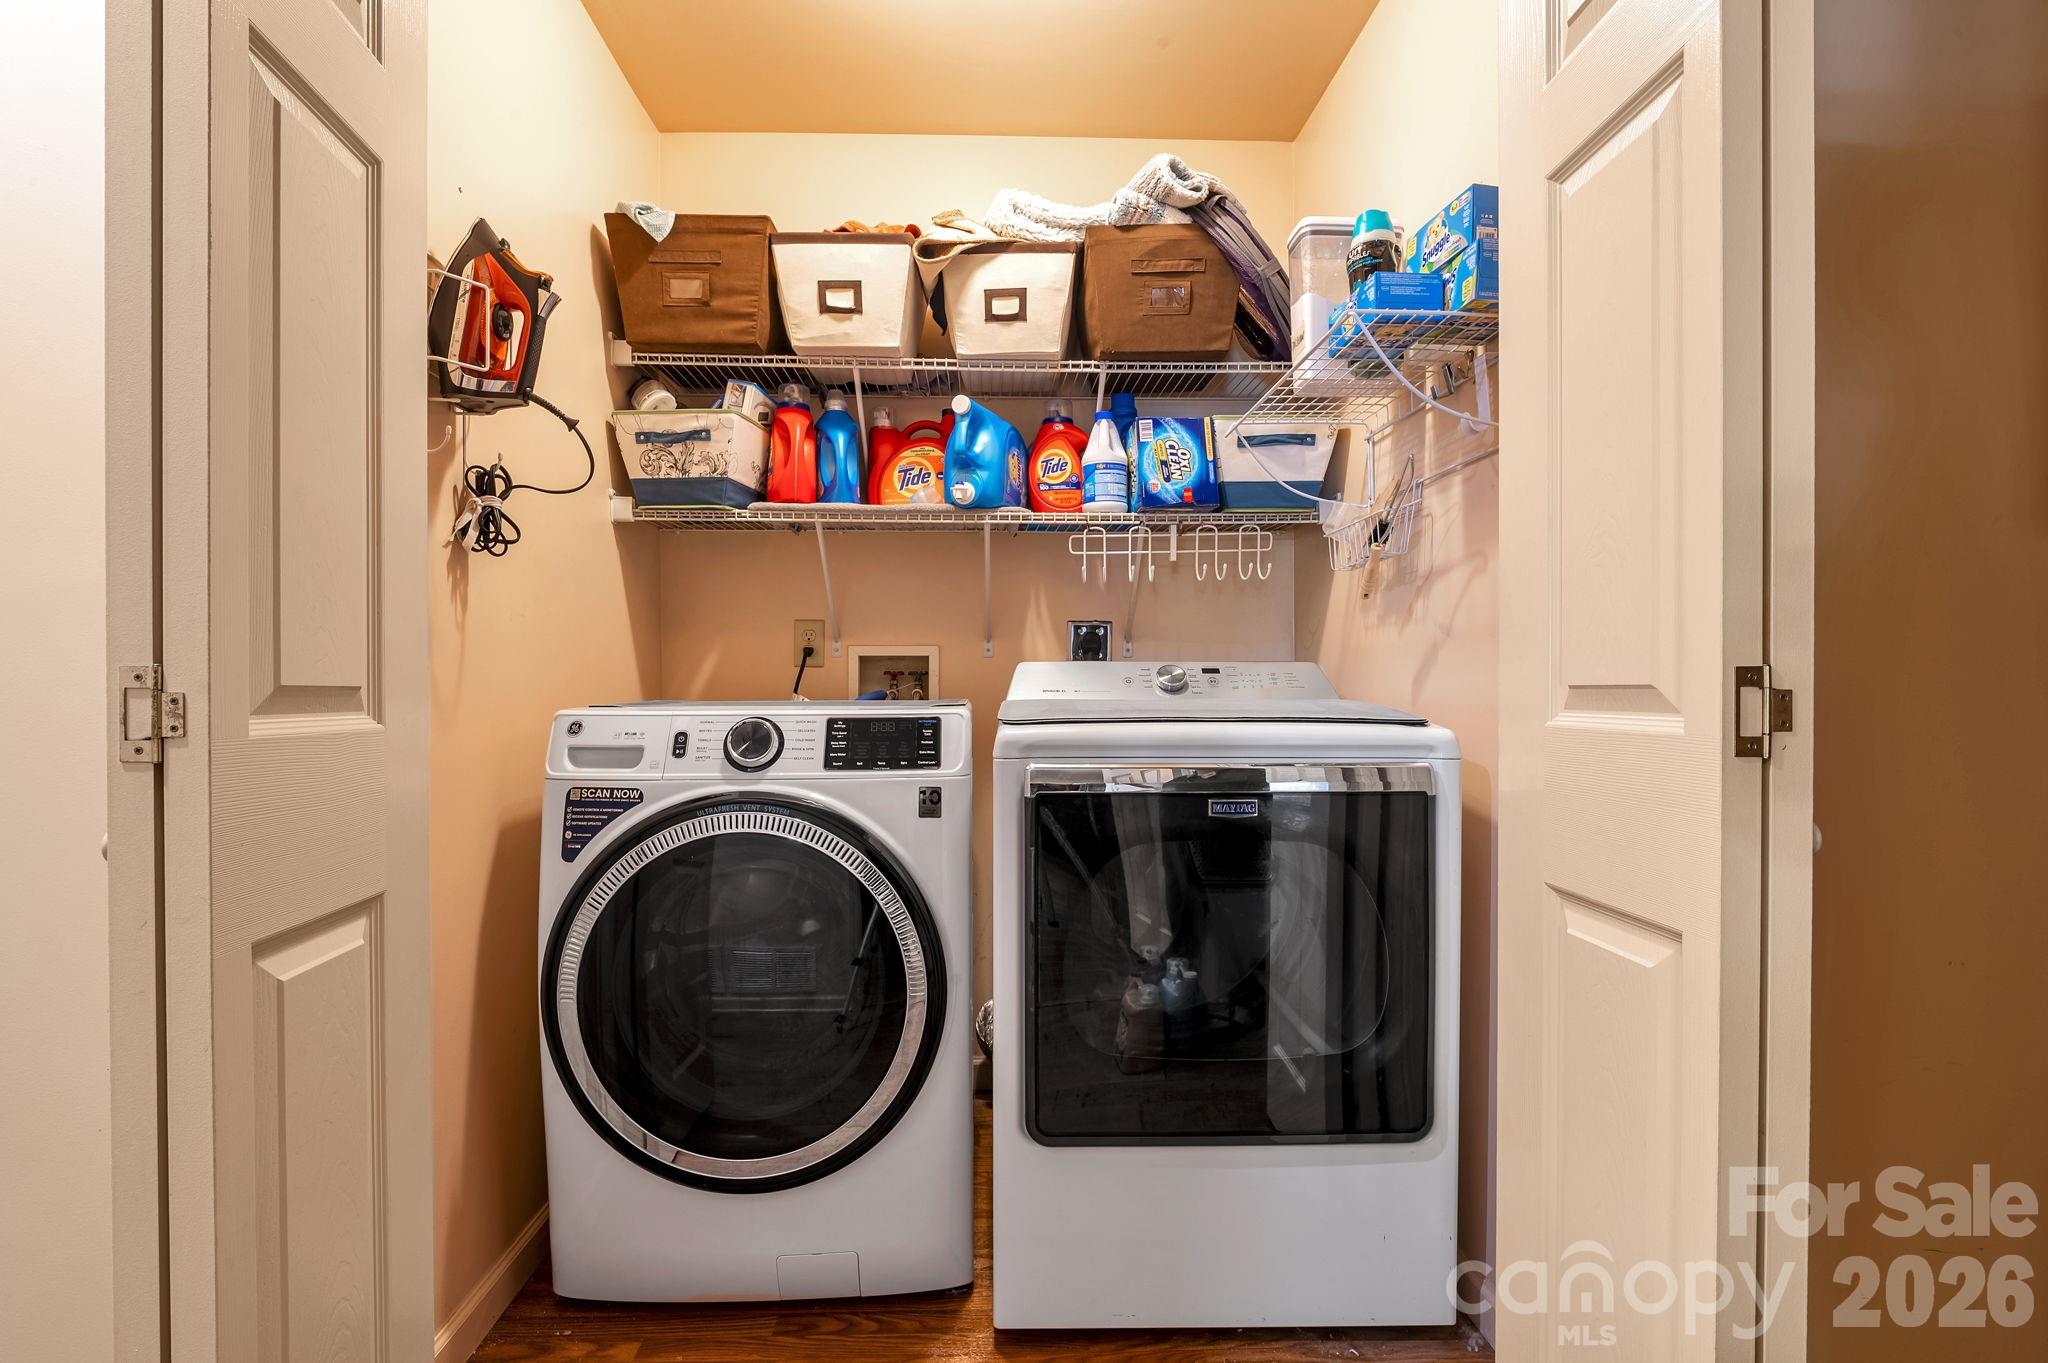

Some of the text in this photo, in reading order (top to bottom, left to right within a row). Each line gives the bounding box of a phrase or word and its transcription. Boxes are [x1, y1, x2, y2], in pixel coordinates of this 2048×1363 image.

[1422, 232, 1451, 268] Snuggle
[1040, 458, 1068, 478] Tide
[1164, 440, 1184, 480] CLEAN
[1178, 448, 1192, 472] OXI
[898, 466, 932, 491] Tide
[581, 789, 640, 798] SCAN NOW
[696, 804, 740, 816] ULTRAFRESH
[764, 806, 790, 815] SYSTEM
[1212, 804, 1255, 813] MAYTAG
